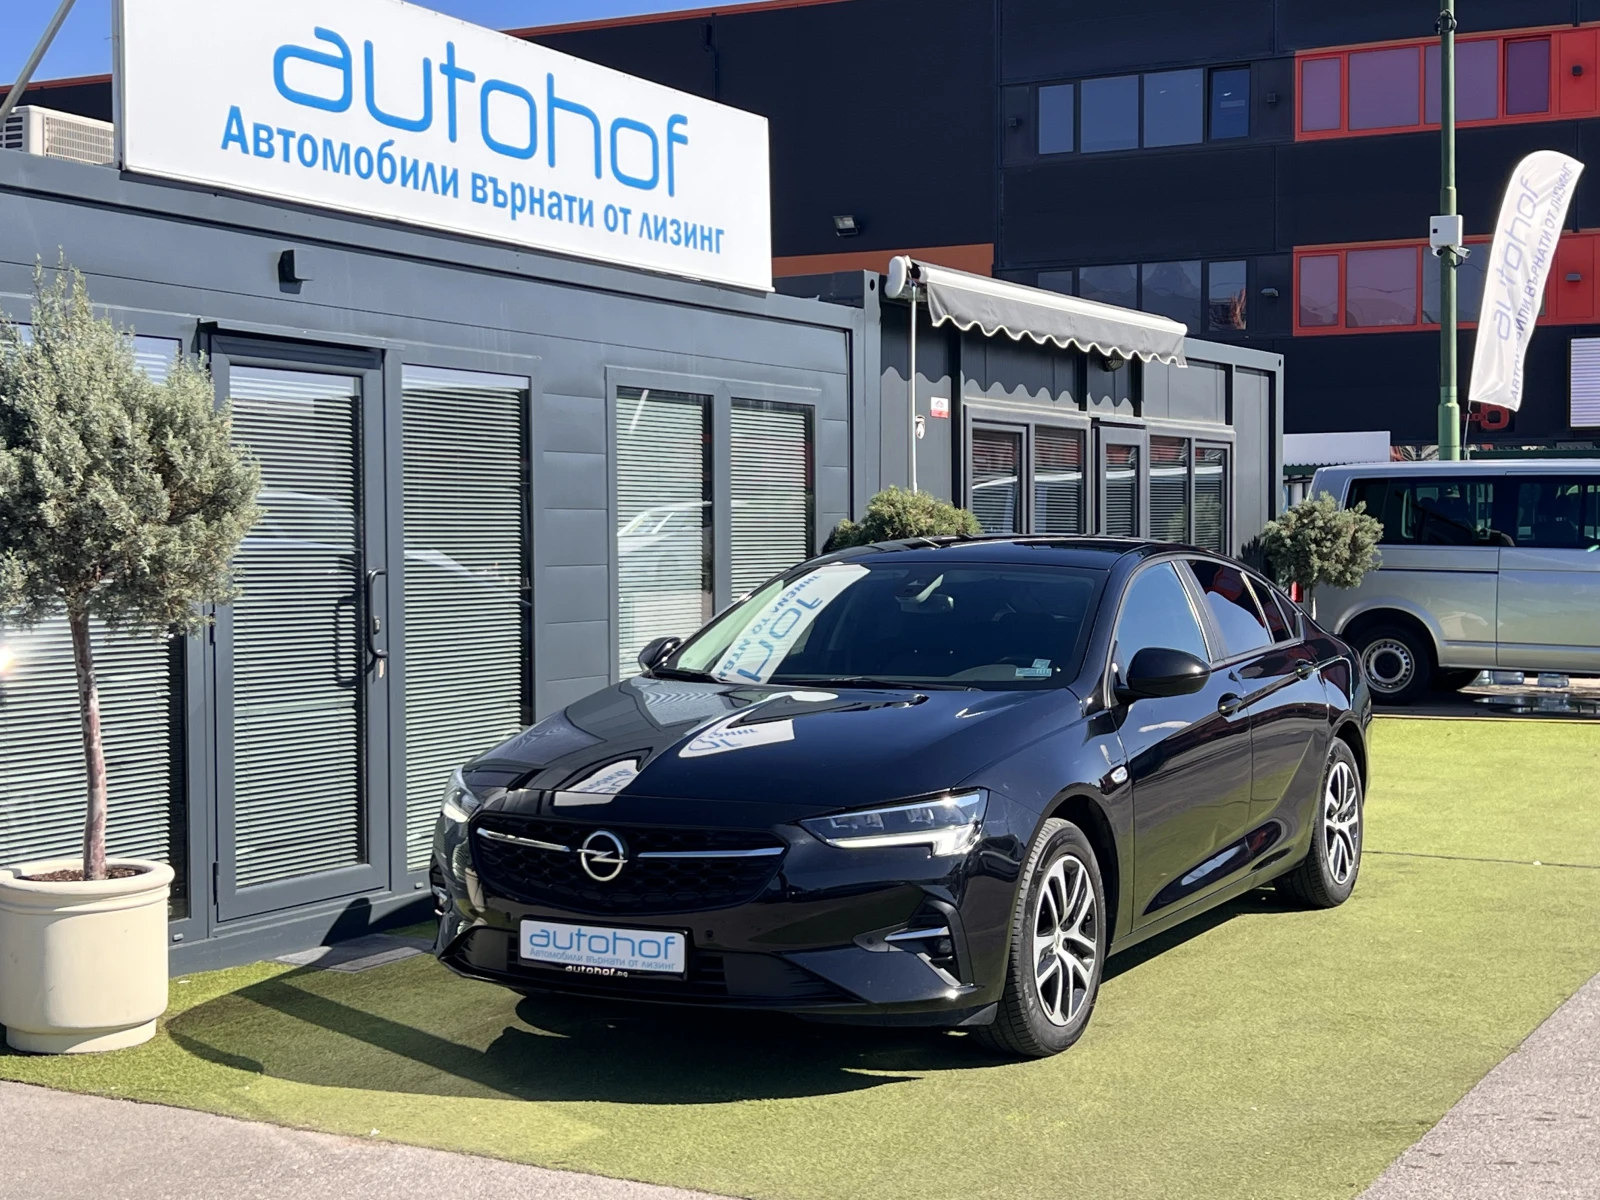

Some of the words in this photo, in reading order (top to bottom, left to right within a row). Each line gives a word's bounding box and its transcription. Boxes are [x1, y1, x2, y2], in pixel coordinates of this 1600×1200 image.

[273, 27, 689, 197] autohof
[221, 106, 459, 199] Автомобили
[471, 173, 594, 228] върнати
[603, 204, 632, 235] от
[639, 213, 724, 254] лизинг
[1524, 229, 1554, 298] ВЪРНАТИ
[1544, 209, 1557, 229] ОТ
[529, 927, 676, 960] autohof
[529, 947, 584, 963] Автомобили
[586, 955, 626, 968] върнати
[628, 960, 639, 968] от
[641, 961, 676, 970] лизинг
